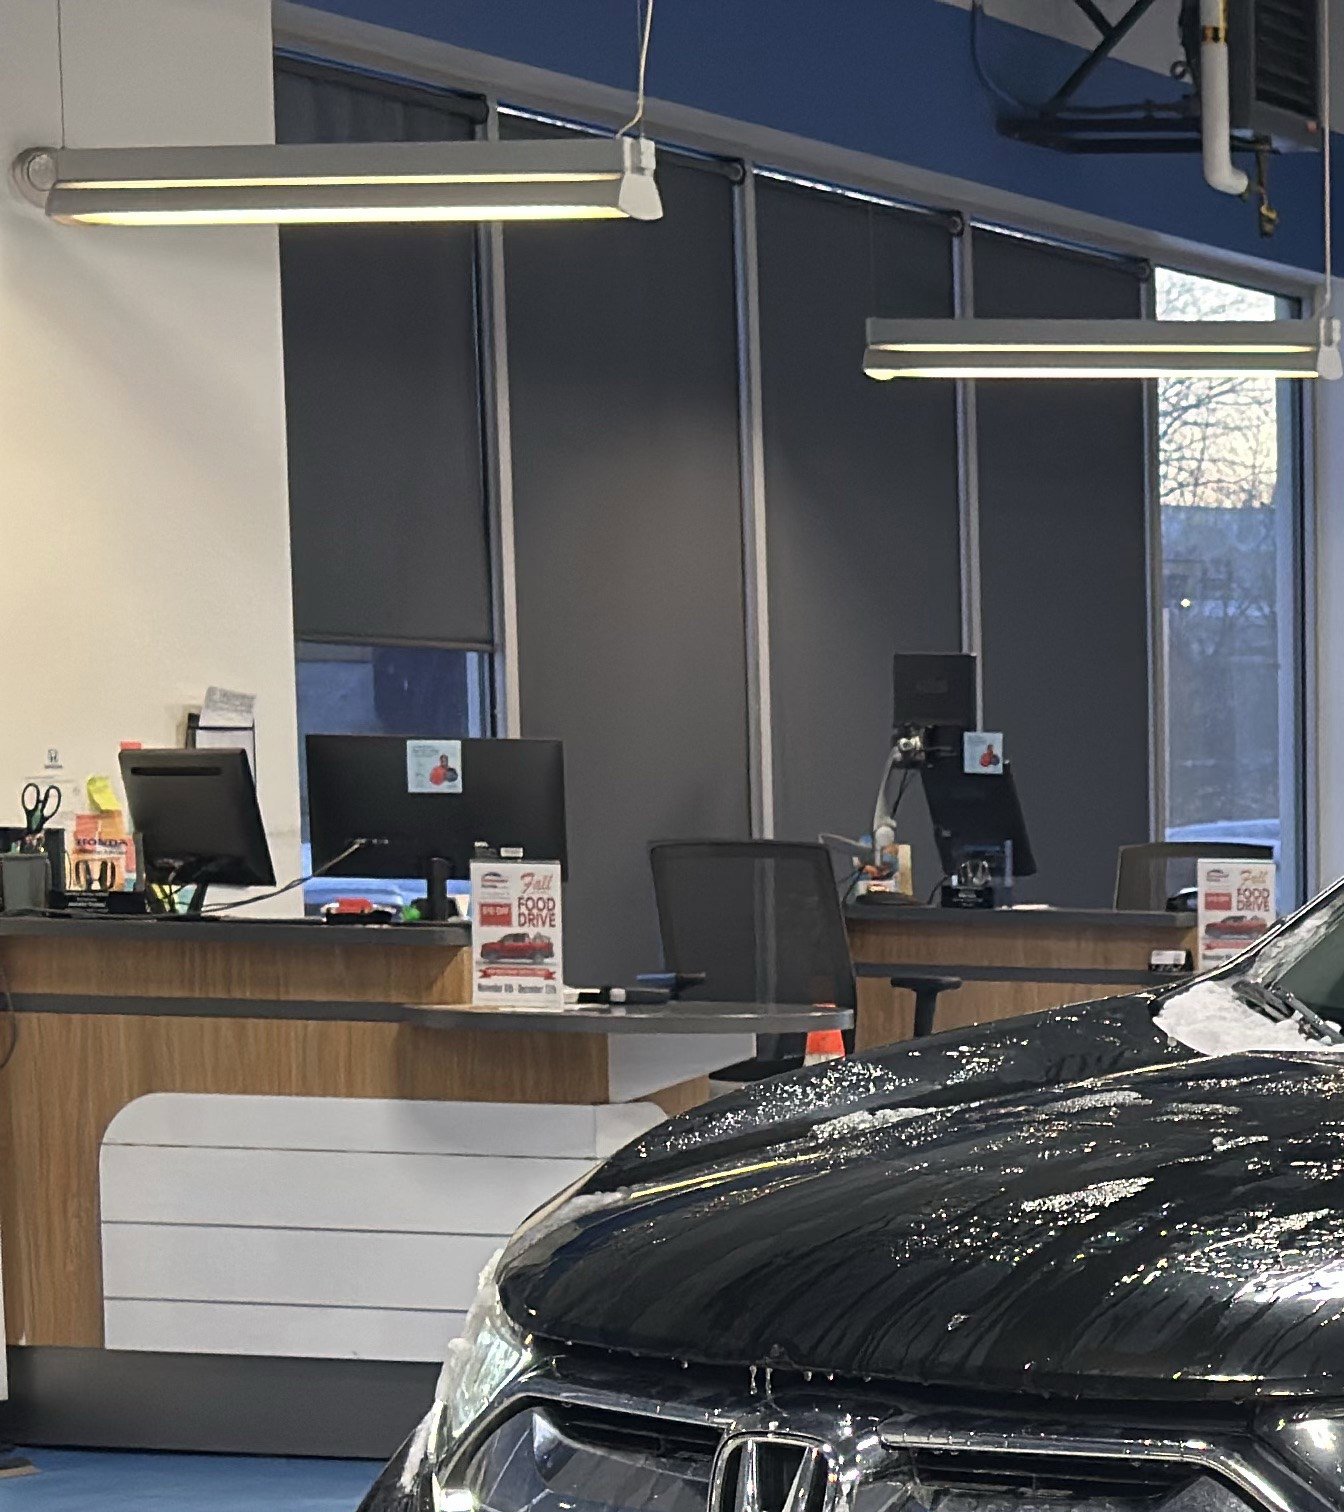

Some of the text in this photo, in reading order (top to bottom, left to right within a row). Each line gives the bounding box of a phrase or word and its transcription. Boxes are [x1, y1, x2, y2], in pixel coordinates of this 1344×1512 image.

[520, 872, 553, 894] Fall
[1237, 888, 1270, 899] FOOD
[518, 897, 556, 912] FOOD
[1237, 900, 1270, 912] DRIVE
[518, 912, 556, 928] DRIVE
